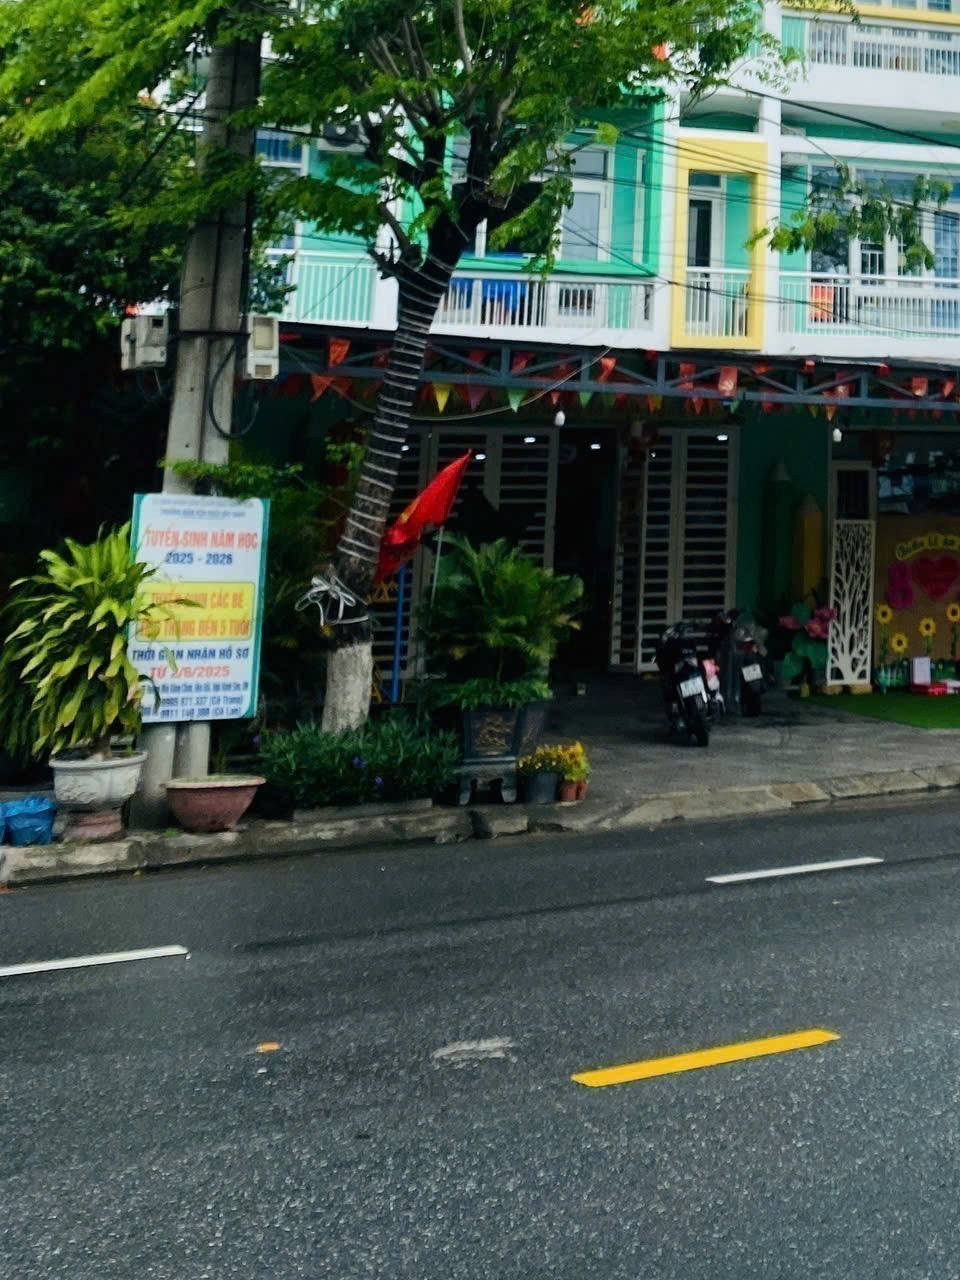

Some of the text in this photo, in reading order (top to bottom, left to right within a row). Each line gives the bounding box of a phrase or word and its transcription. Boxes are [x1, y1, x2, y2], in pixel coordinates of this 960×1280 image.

[145, 525, 258, 552] TUYỂN SINH NĂM HỌC
[166, 552, 194, 564] 2025
[206, 553, 233, 565] 2026
[164, 617, 195, 636] THNG
[158, 649, 183, 661] GAN
